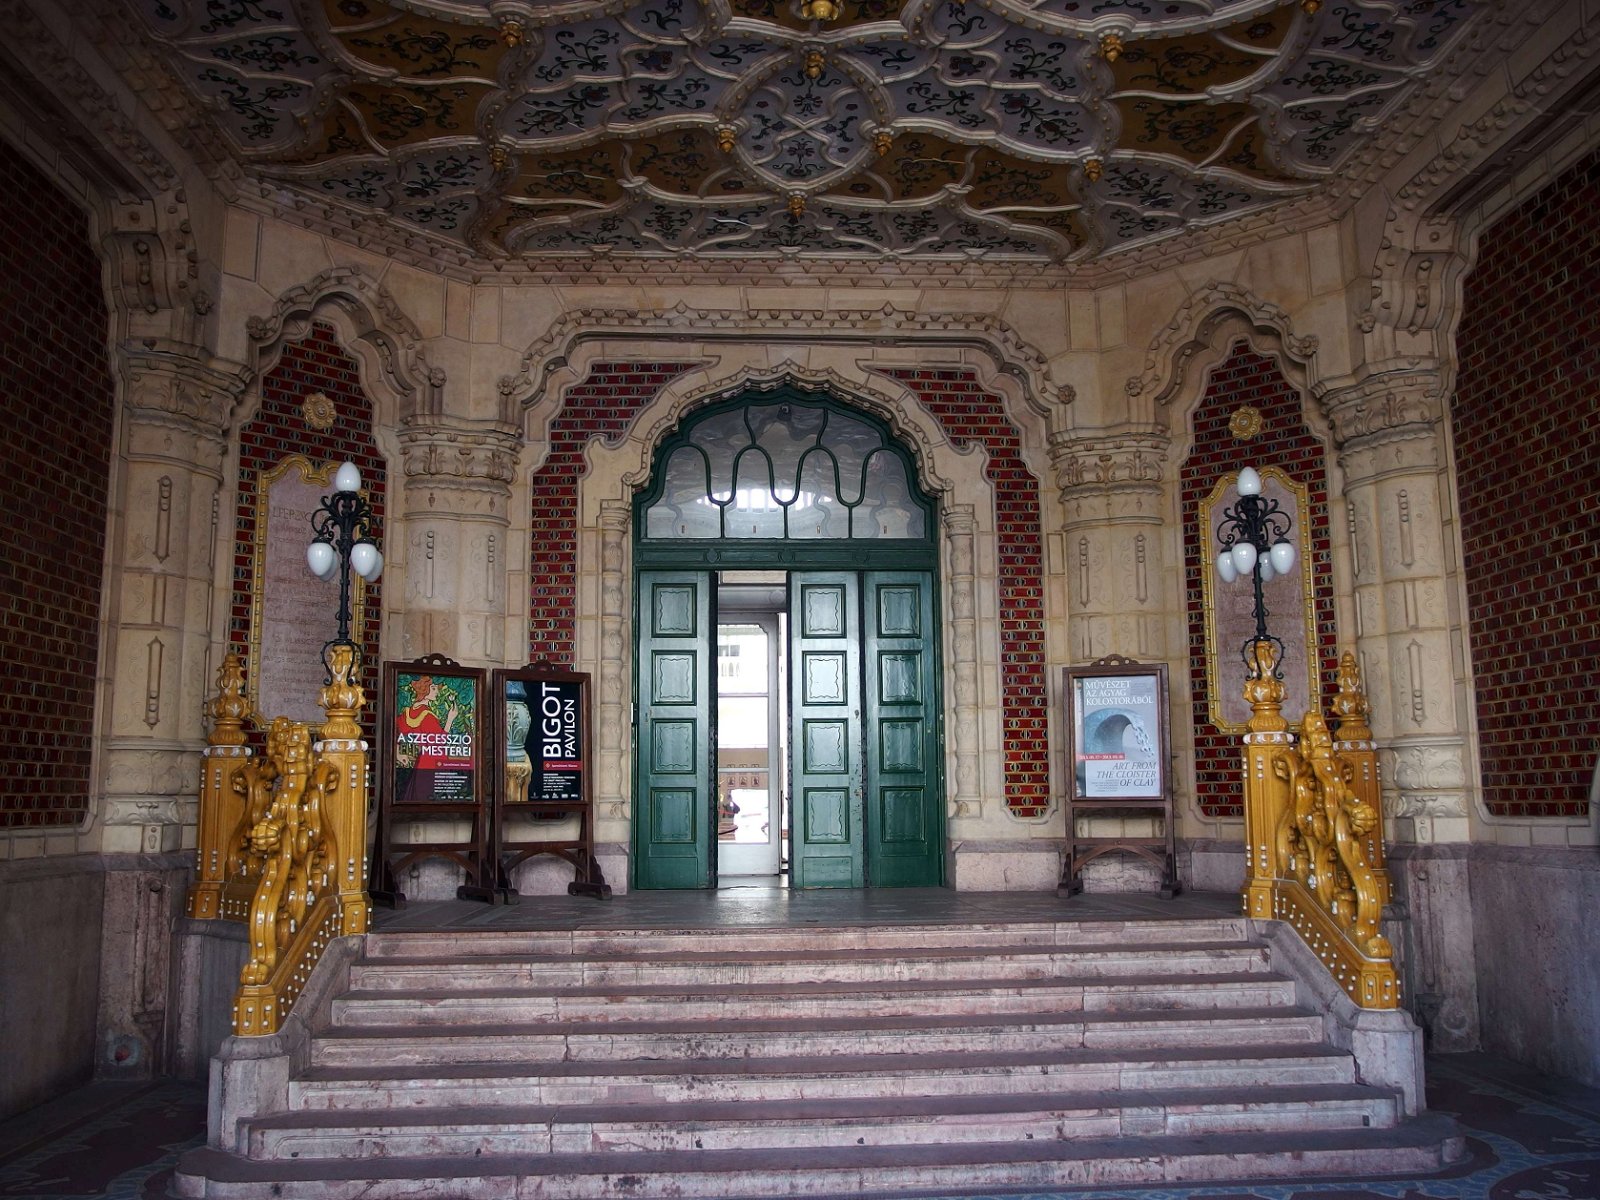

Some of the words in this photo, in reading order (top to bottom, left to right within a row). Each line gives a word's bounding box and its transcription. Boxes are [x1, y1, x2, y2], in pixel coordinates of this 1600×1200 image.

[1086, 689, 1097, 697] AZ
[1099, 689, 1126, 697] AGYAG
[1086, 695, 1153, 706] KOLOSTORÁBÓL
[542, 681, 561, 758] BIGOT
[564, 699, 576, 758] PAVILON
[397, 732, 406, 743] A
[407, 732, 472, 745] SZECESSZIÓ
[421, 745, 471, 757] MESTEREI
[1112, 762, 1129, 770] ART
[1131, 762, 1156, 770] FROM
[1097, 771, 1115, 779] THE
[1116, 770, 1156, 779] CLOISTER
[1120, 779, 1132, 787] OF
[1133, 779, 1155, 787] CLAY
